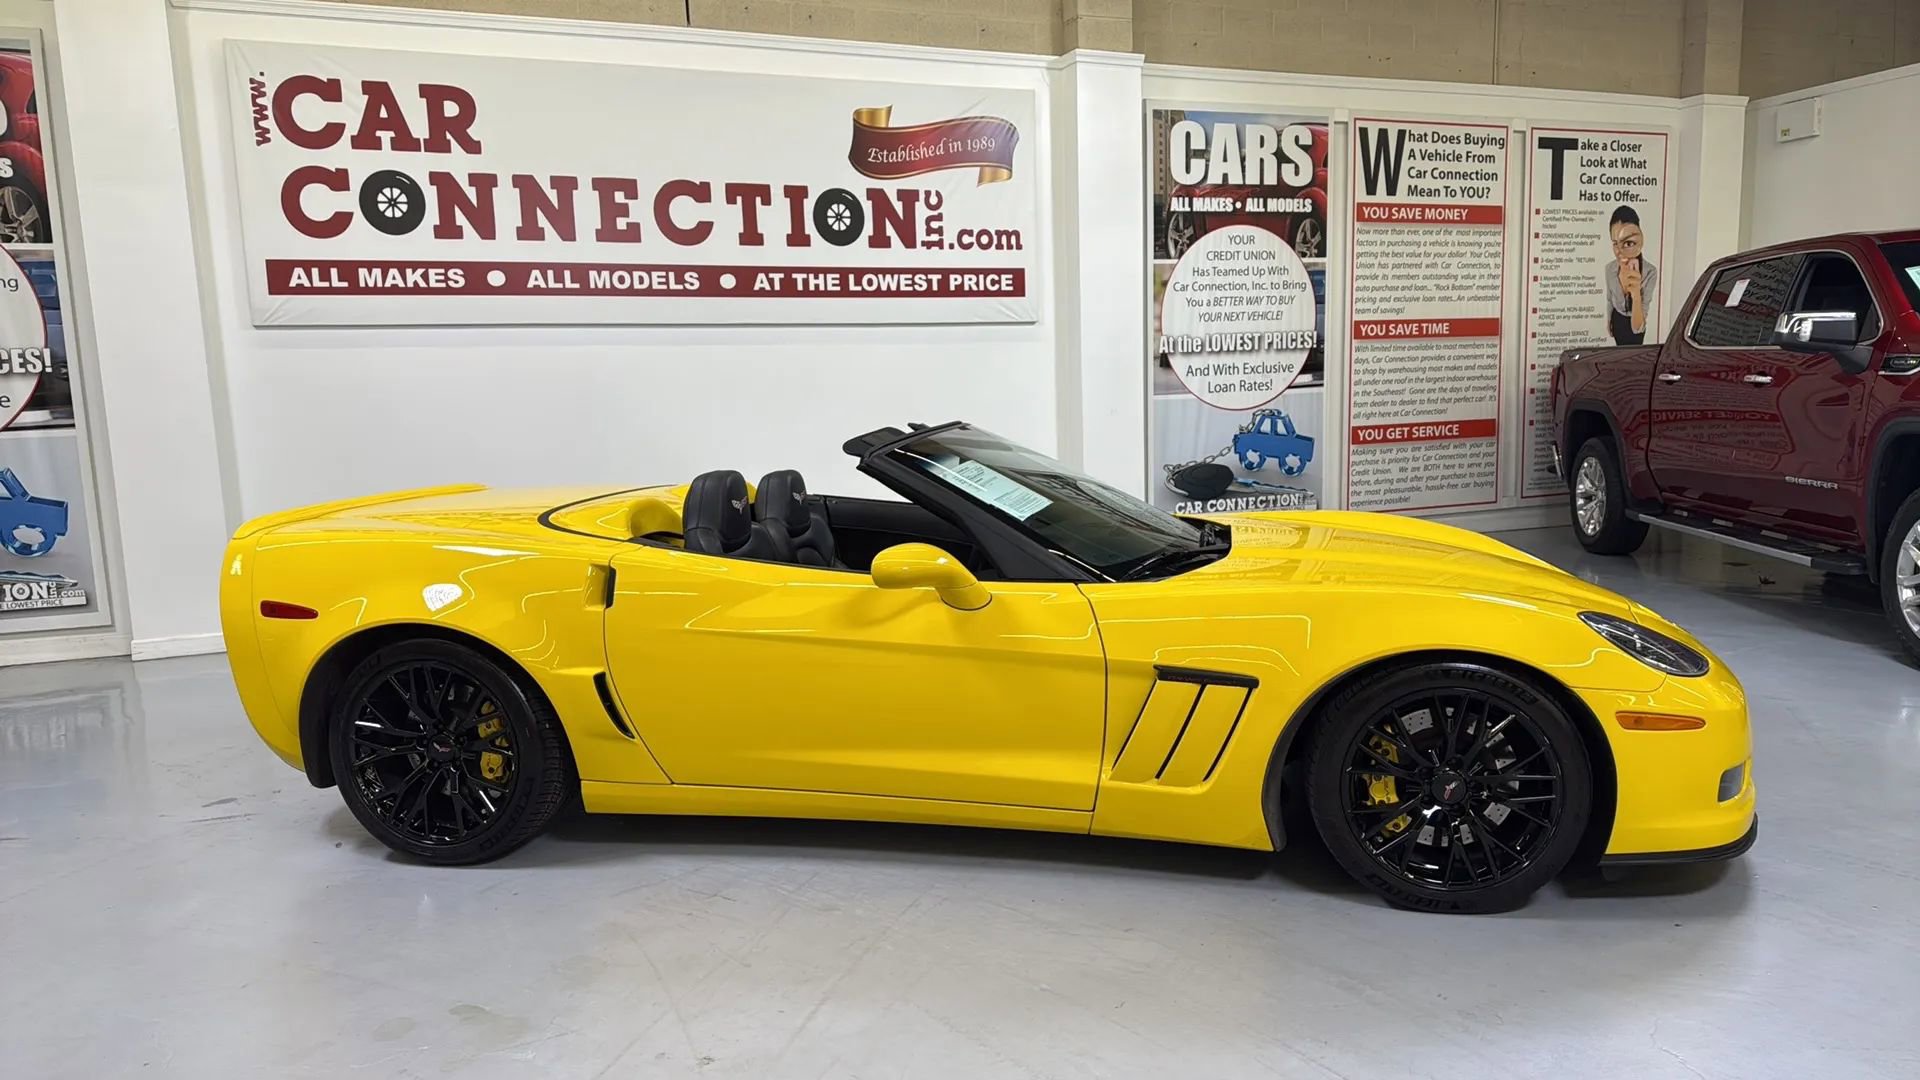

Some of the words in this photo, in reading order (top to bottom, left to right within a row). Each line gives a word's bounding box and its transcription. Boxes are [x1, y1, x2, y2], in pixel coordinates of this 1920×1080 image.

[272, 75, 482, 154] CAR
[1432, 132, 1461, 144] Does
[1464, 133, 1505, 149] Buying
[1602, 142, 1607, 151] a
[1610, 140, 1642, 152] Closer
[868, 137, 947, 163] Established
[949, 139, 962, 152] in
[967, 136, 995, 151] 1989
[1170, 121, 1313, 187] CARS
[1408, 149, 1416, 161] A
[1420, 149, 1462, 162] Vehicle
[1466, 151, 1495, 163] From
[1580, 156, 1606, 168] Look
[1608, 158, 1618, 168] at
[1621, 158, 1647, 169] What
[1408, 167, 1427, 179] Car
[1431, 168, 1498, 181] Connection
[1580, 173, 1597, 185] Car
[1600, 174, 1657, 186] Connection
[1408, 185, 1440, 197] Mean
[1444, 186, 1456, 197] To
[1460, 187, 1490, 199] YOU?
[1579, 190, 1598, 201] Has
[1601, 191, 1611, 201] to
[1614, 190, 1648, 202] Offer...
[1170, 198, 1191, 212] ALL
[1193, 198, 1233, 212] MAKES
[1246, 198, 1265, 212] ALL
[1268, 198, 1312, 212] MODELS
[1363, 207, 1388, 219] YOU
[1392, 207, 1422, 219] SAVE
[1425, 209, 1468, 220] MONEY
[1435, 228, 1443, 236] of
[1443, 228, 1452, 236] the
[1473, 229, 1501, 237] important
[949, 228, 1023, 251] .com
[1228, 235, 1255, 245] YOUR
[1207, 251, 1241, 261] CREDIT
[1244, 251, 1275, 260] UNION
[1356, 251, 1378, 259] getting
[1193, 267, 1210, 276] Has
[1212, 267, 1249, 276] Teamed
[1252, 267, 1265, 277] Up
[1267, 266, 1289, 276] With
[288, 267, 348, 288] ALL
[358, 267, 465, 289] MAKES
[527, 269, 579, 289] ALL
[589, 270, 700, 290] MODELS
[754, 273, 784, 291] AT
[792, 273, 841, 291] THE
[849, 273, 941, 292] LOWEST
[949, 274, 1013, 292] PRICE
[1173, 282, 1188, 292] Car
[1192, 281, 1249, 291] Connection,
[1252, 281, 1268, 290] Inc.
[1271, 282, 1280, 290] to
[1283, 281, 1307, 292] Bring
[1186, 298, 1203, 307] You
[1213, 297, 1244, 307] BETTER
[1246, 296, 1264, 306] WAY
[1266, 296, 1277, 305] TO
[1279, 295, 1295, 304] BUY
[1199, 312, 1223, 322] YOUR
[1224, 311, 1246, 321] NEXT
[1248, 311, 1283, 321] VEHICLE!
[1380, 307, 1405, 315] savings!
[1360, 324, 1385, 336] YOU
[1389, 324, 1419, 335] SAVE
[1421, 323, 1449, 334] TIME
[1159, 335, 1174, 353] At
[1177, 335, 1201, 352] the
[1205, 332, 1260, 351] LOWEST
[1265, 330, 1317, 349] PRICES!
[1354, 357, 1370, 365] days,
[1385, 355, 1419, 363] Connection
[1420, 355, 1445, 363] provides
[1186, 364, 1209, 376] And
[1213, 364, 1239, 376] With
[1243, 362, 1294, 375] Exclusive
[1208, 381, 1236, 393] Loan
[1240, 379, 1273, 391] Rates!
[1353, 411, 1361, 419] all
[1363, 410, 1377, 420] right
[1378, 410, 1391, 418] here
[1400, 409, 1410, 417] Car
[1412, 408, 1448, 416] Connection!
[1358, 429, 1383, 441] YOU
[1387, 428, 1409, 439] GET
[1412, 424, 1459, 437] SERVICE
[1396, 447, 1408, 455] you
[1425, 443, 1450, 451] satisfied
[1351, 469, 1370, 477] Credit
[1785, 476, 1838, 489] SIERRA
[1176, 501, 1203, 514] CAR
[1207, 493, 1299, 512] CONNECTION
[1351, 499, 1383, 508] experience
[1384, 496, 1411, 505] possible!
[6, 601, 39, 609] LOWEST
